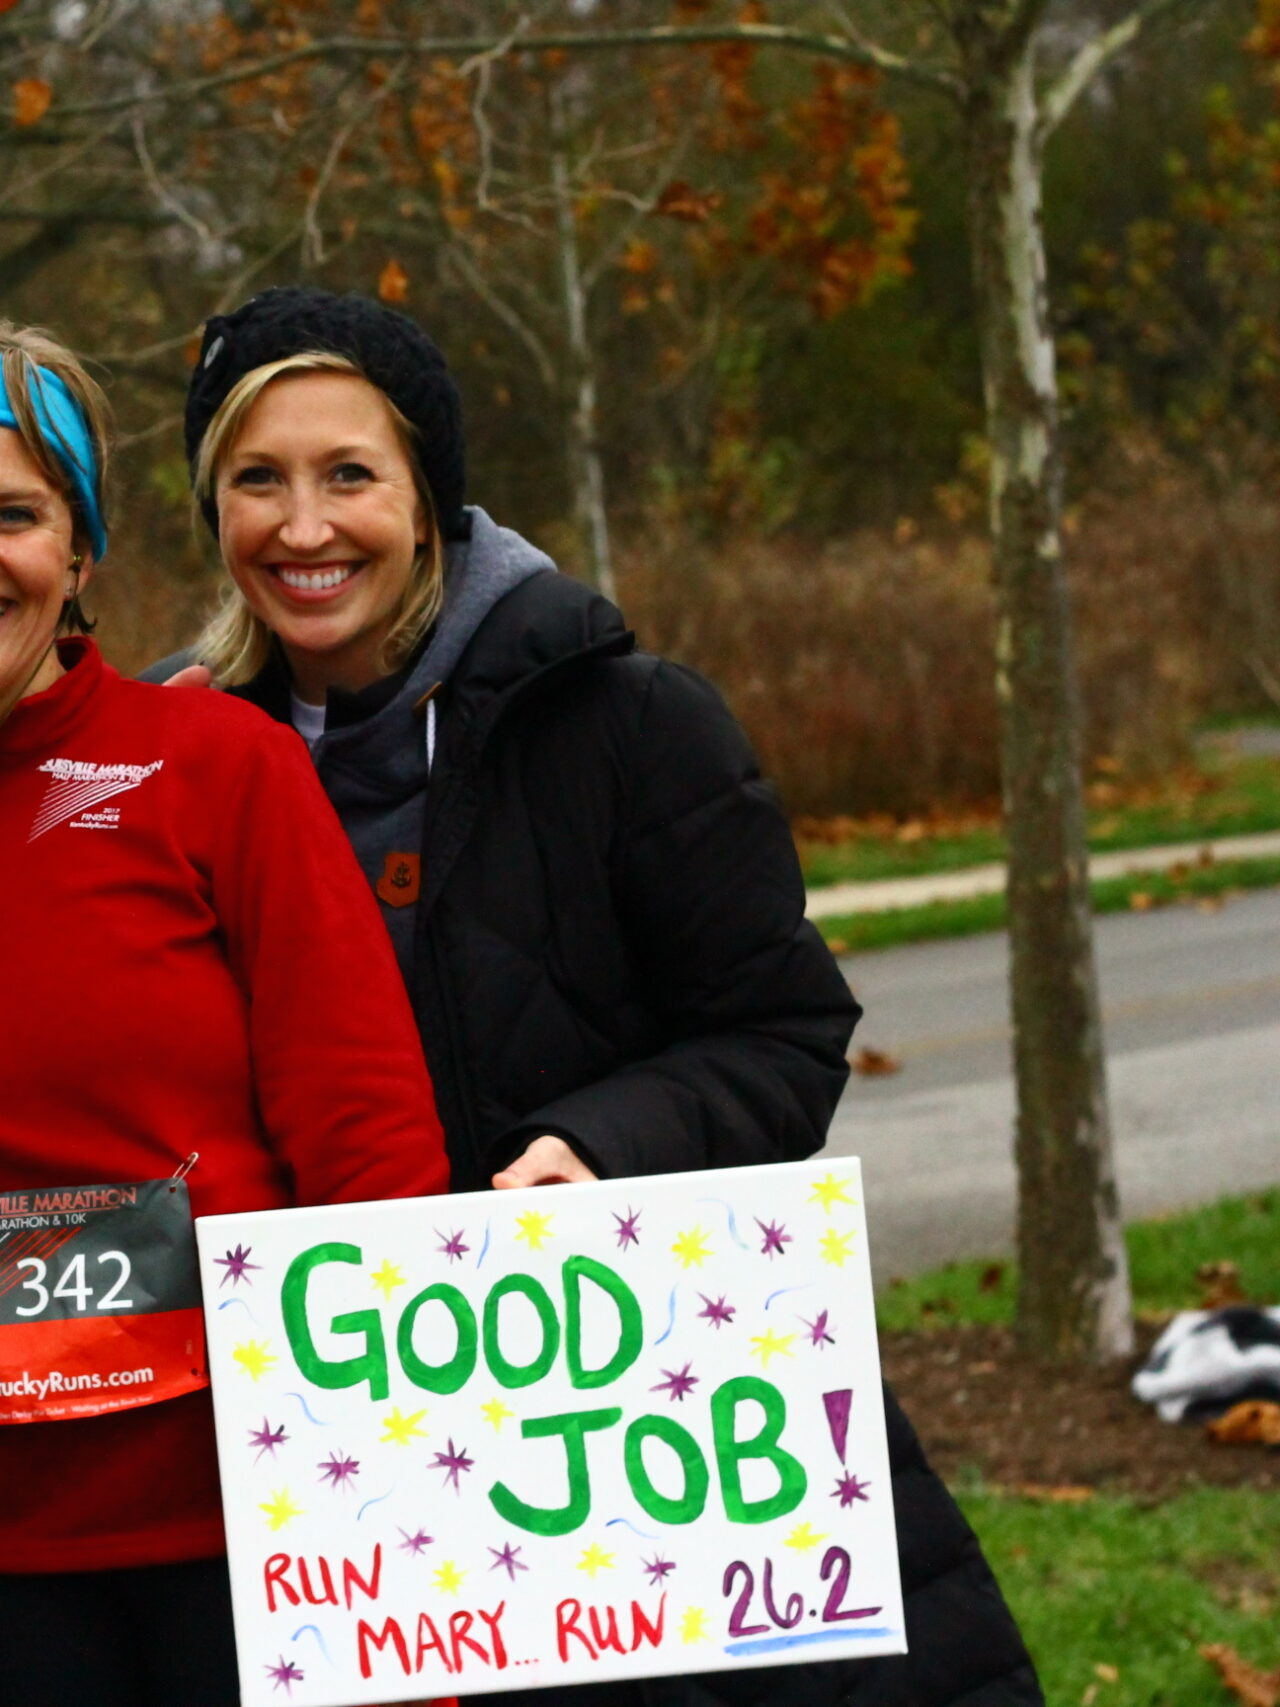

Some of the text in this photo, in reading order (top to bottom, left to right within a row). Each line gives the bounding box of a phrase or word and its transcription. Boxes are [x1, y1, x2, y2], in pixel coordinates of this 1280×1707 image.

[95, 760, 164, 778] MARATHON
[81, 813, 120, 821] FINISHER
[33, 1187, 137, 1212] MARATHON
[53, 1215, 61, 1226] &
[65, 1213, 87, 1225] 10K
[280, 1242, 644, 1402] GOOD
[263, 1543, 382, 1611] RUN
[357, 1547, 883, 1679] MARY... RUN 26.2
